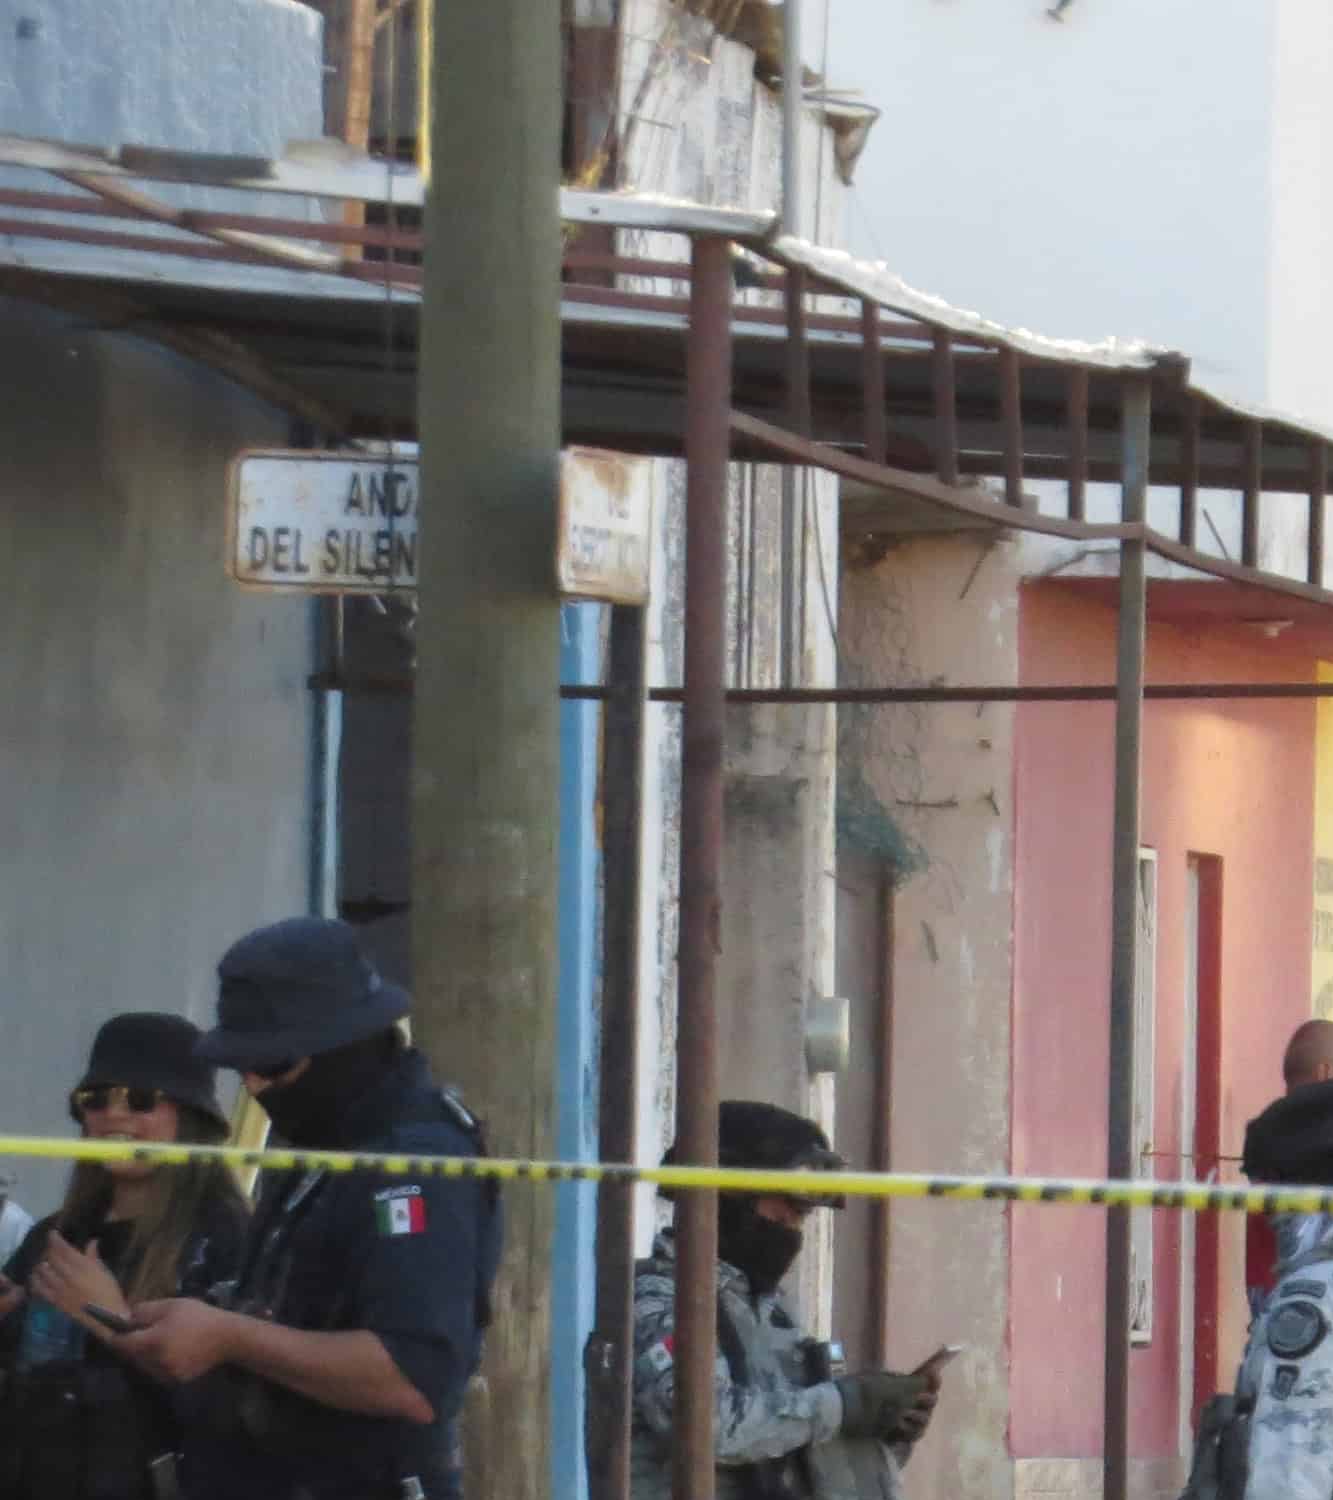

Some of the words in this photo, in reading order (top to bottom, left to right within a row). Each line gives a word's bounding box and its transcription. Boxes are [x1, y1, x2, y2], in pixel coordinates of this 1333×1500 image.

[345, 472, 418, 518] AND
[249, 526, 309, 574] DEL
[321, 529, 416, 577] SILEN
